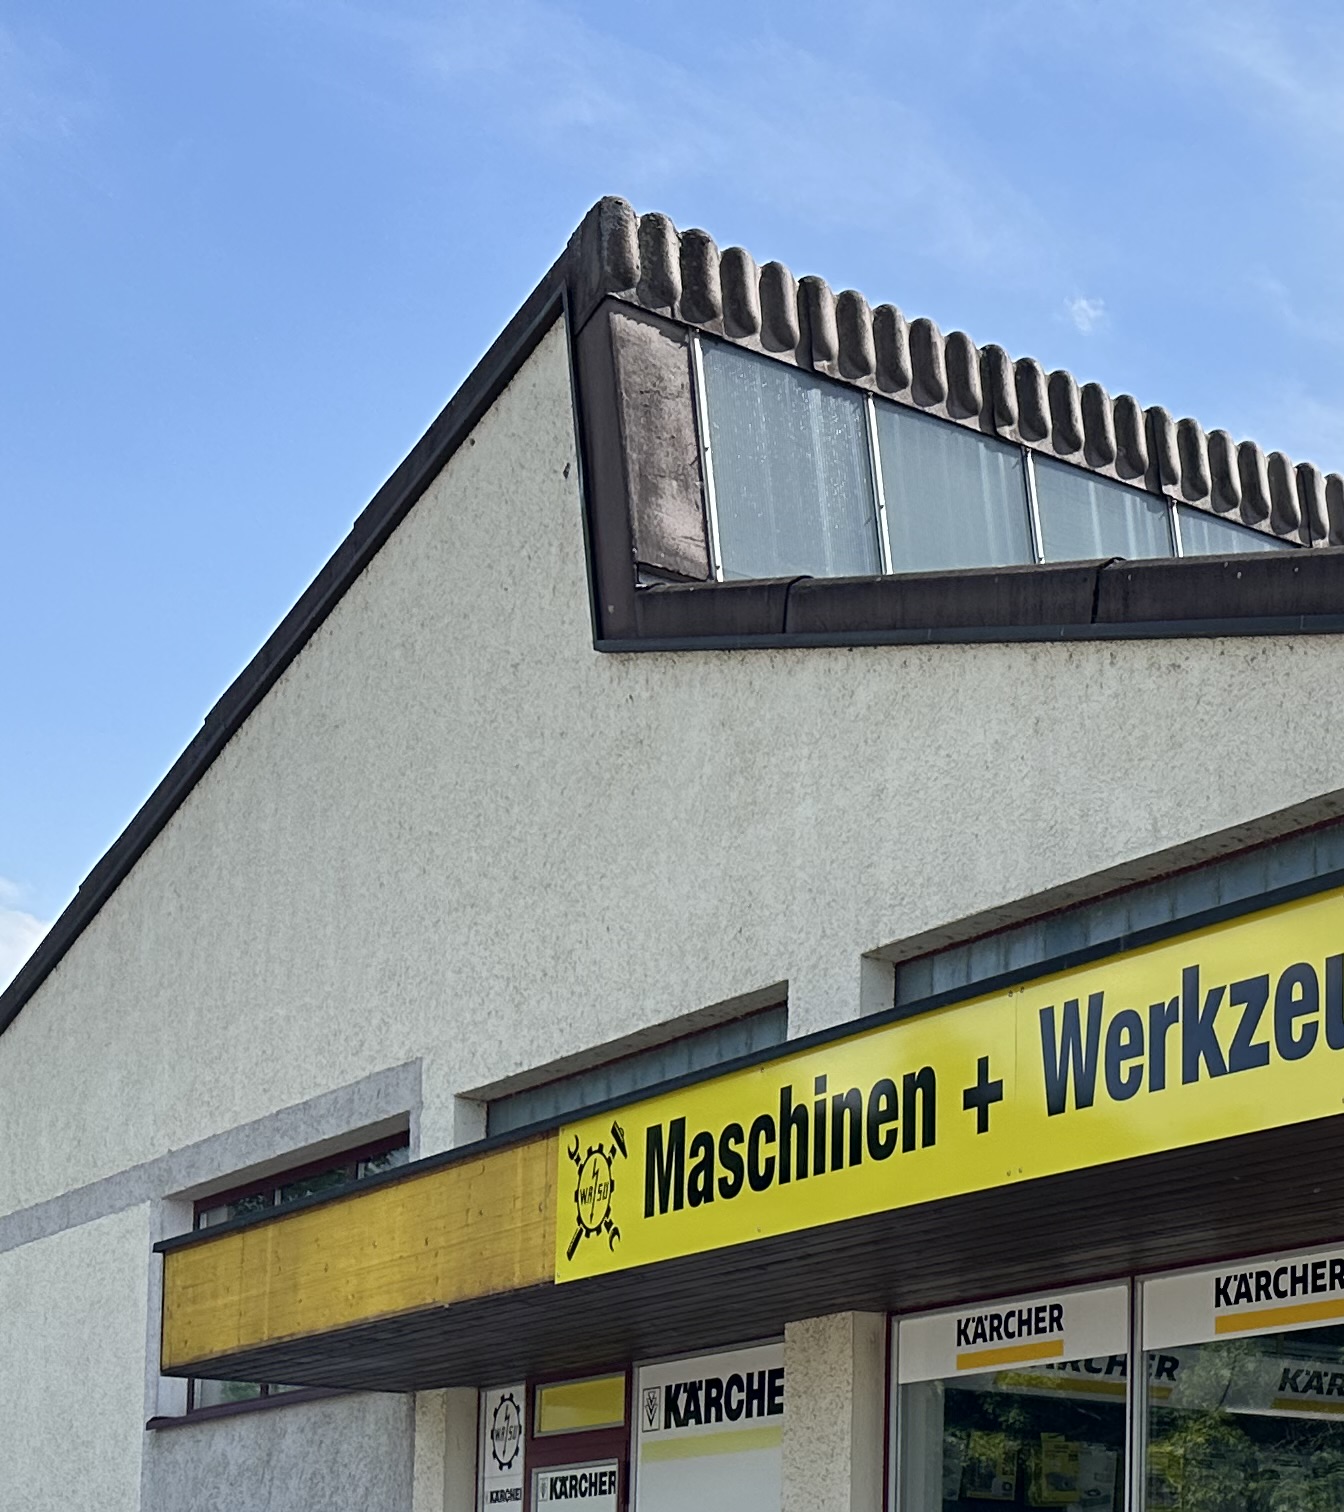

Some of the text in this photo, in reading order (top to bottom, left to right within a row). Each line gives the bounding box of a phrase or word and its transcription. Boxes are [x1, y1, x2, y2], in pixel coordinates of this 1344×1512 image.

[643, 1063, 937, 1219] Maschinen
[962, 1056, 1003, 1135] +
[956, 1304, 1064, 1348] KÄRCHER
[664, 1367, 785, 1429] KÄRCHE
